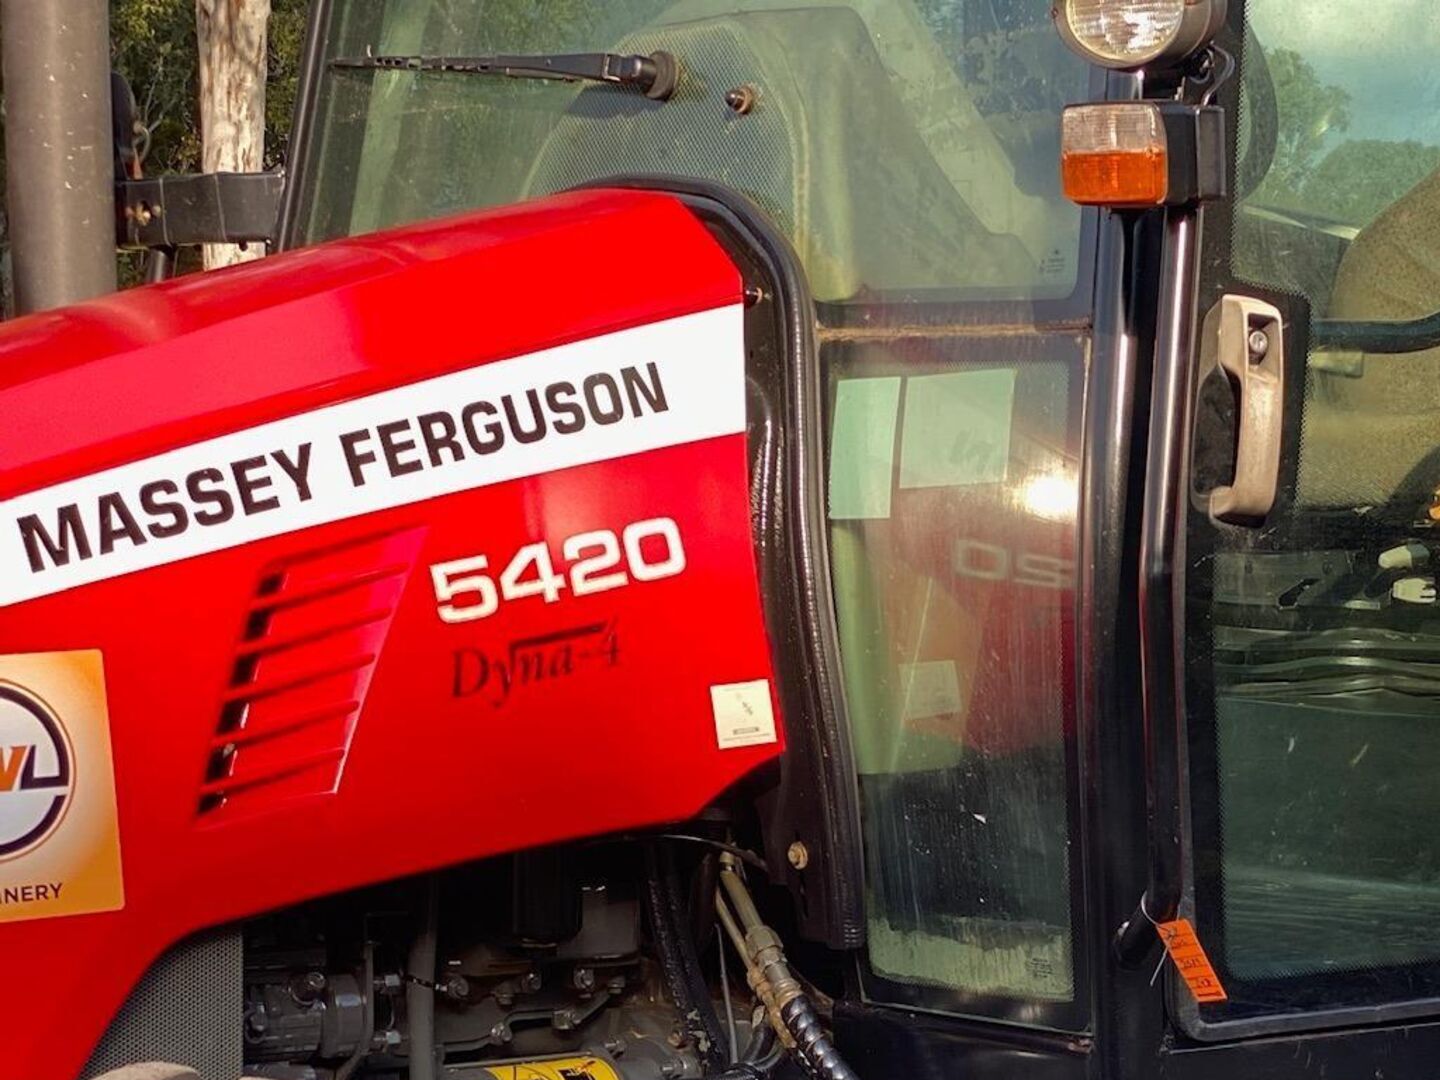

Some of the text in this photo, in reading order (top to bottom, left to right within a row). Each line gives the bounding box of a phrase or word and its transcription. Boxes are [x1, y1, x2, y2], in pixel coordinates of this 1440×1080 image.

[16, 361, 670, 573] MASSEY FERGUSON
[430, 517, 687, 624] 5420
[450, 616, 622, 709] Dyna-4
